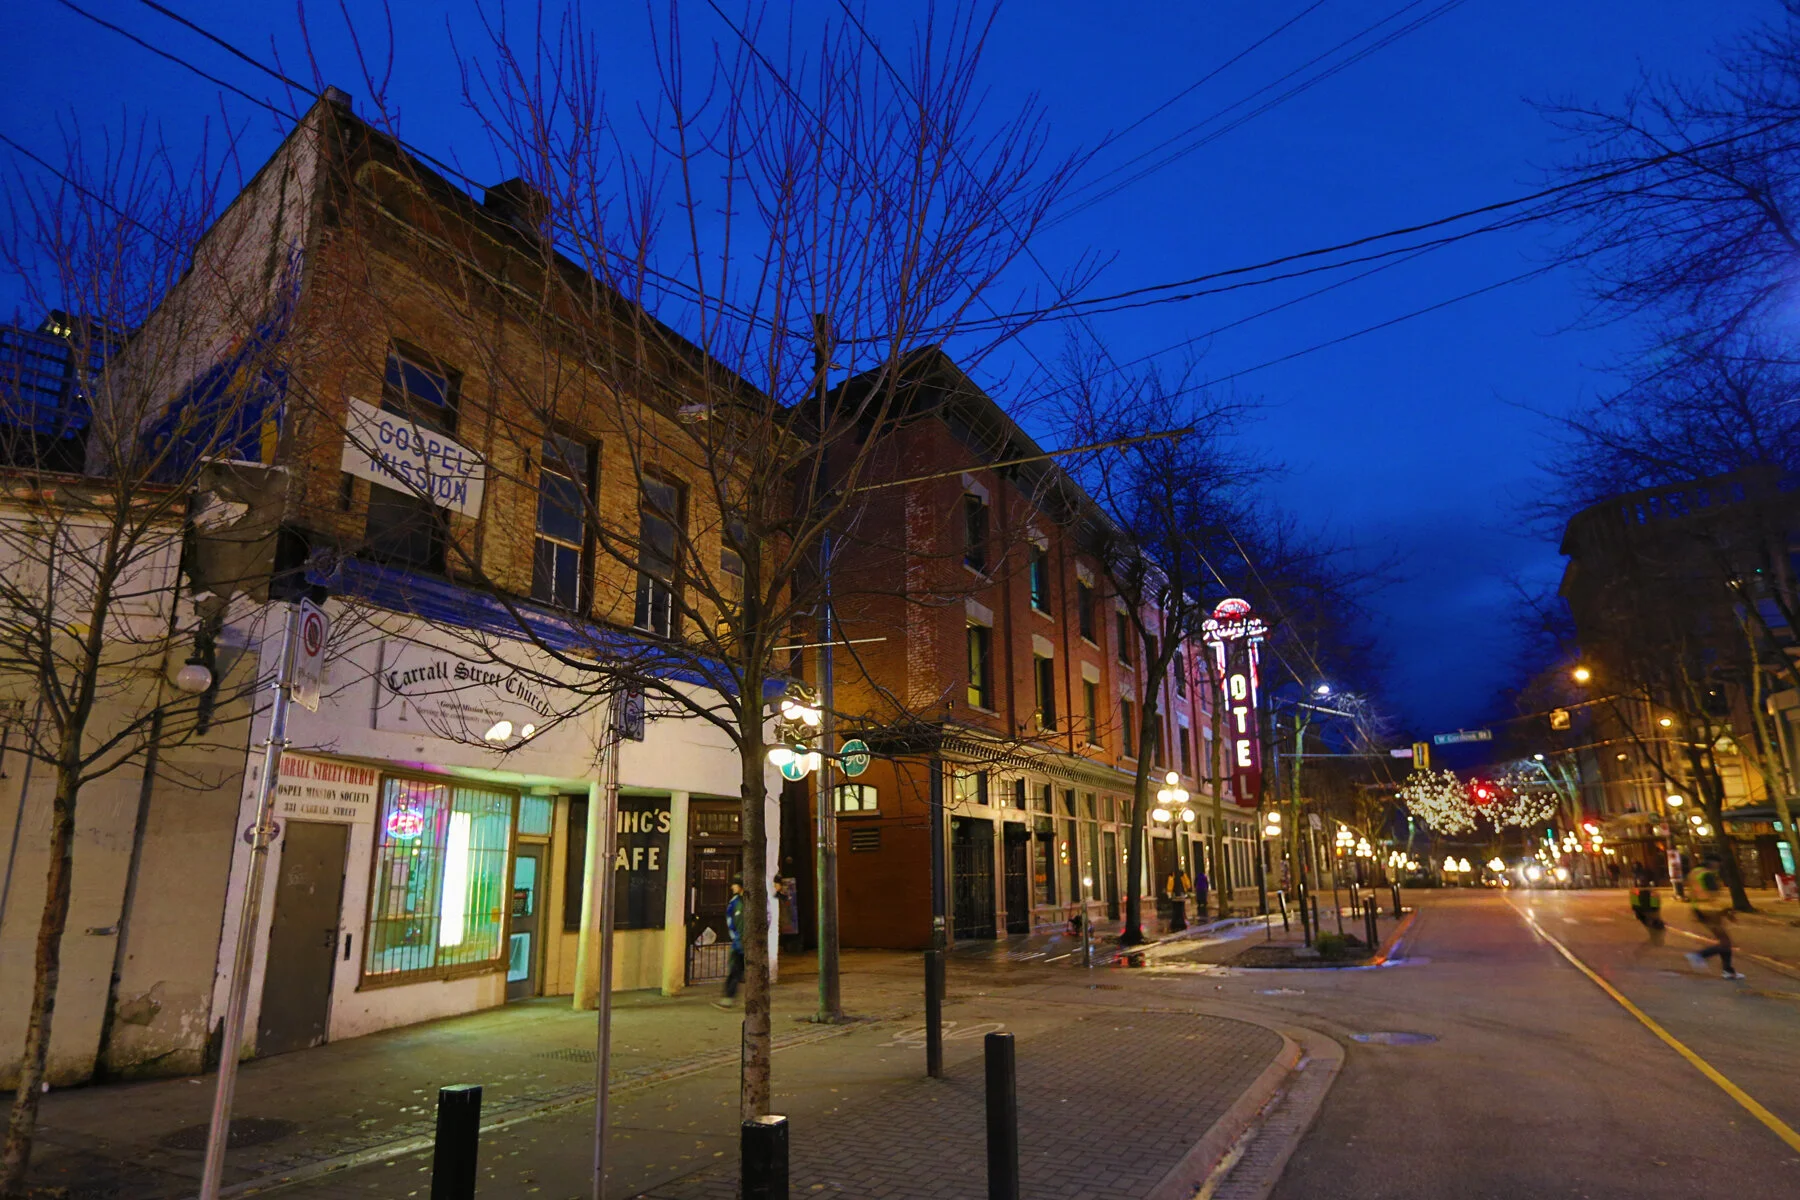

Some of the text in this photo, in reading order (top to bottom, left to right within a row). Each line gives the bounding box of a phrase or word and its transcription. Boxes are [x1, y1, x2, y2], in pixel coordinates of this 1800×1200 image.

[379, 421, 469, 476] GOSPEL
[370, 453, 468, 506] MISSION
[386, 661, 549, 717] Carrall Street Church
[462, 703, 483, 714] Mission
[1230, 673, 1254, 800] OTEL
[280, 757, 375, 787] ARRALL STREET CHURCH
[277, 784, 370, 804] OSPEL MISSION SOCIETY
[333, 806, 357, 818] STREET
[616, 808, 671, 834] ING'S
[616, 847, 661, 871] AFE
